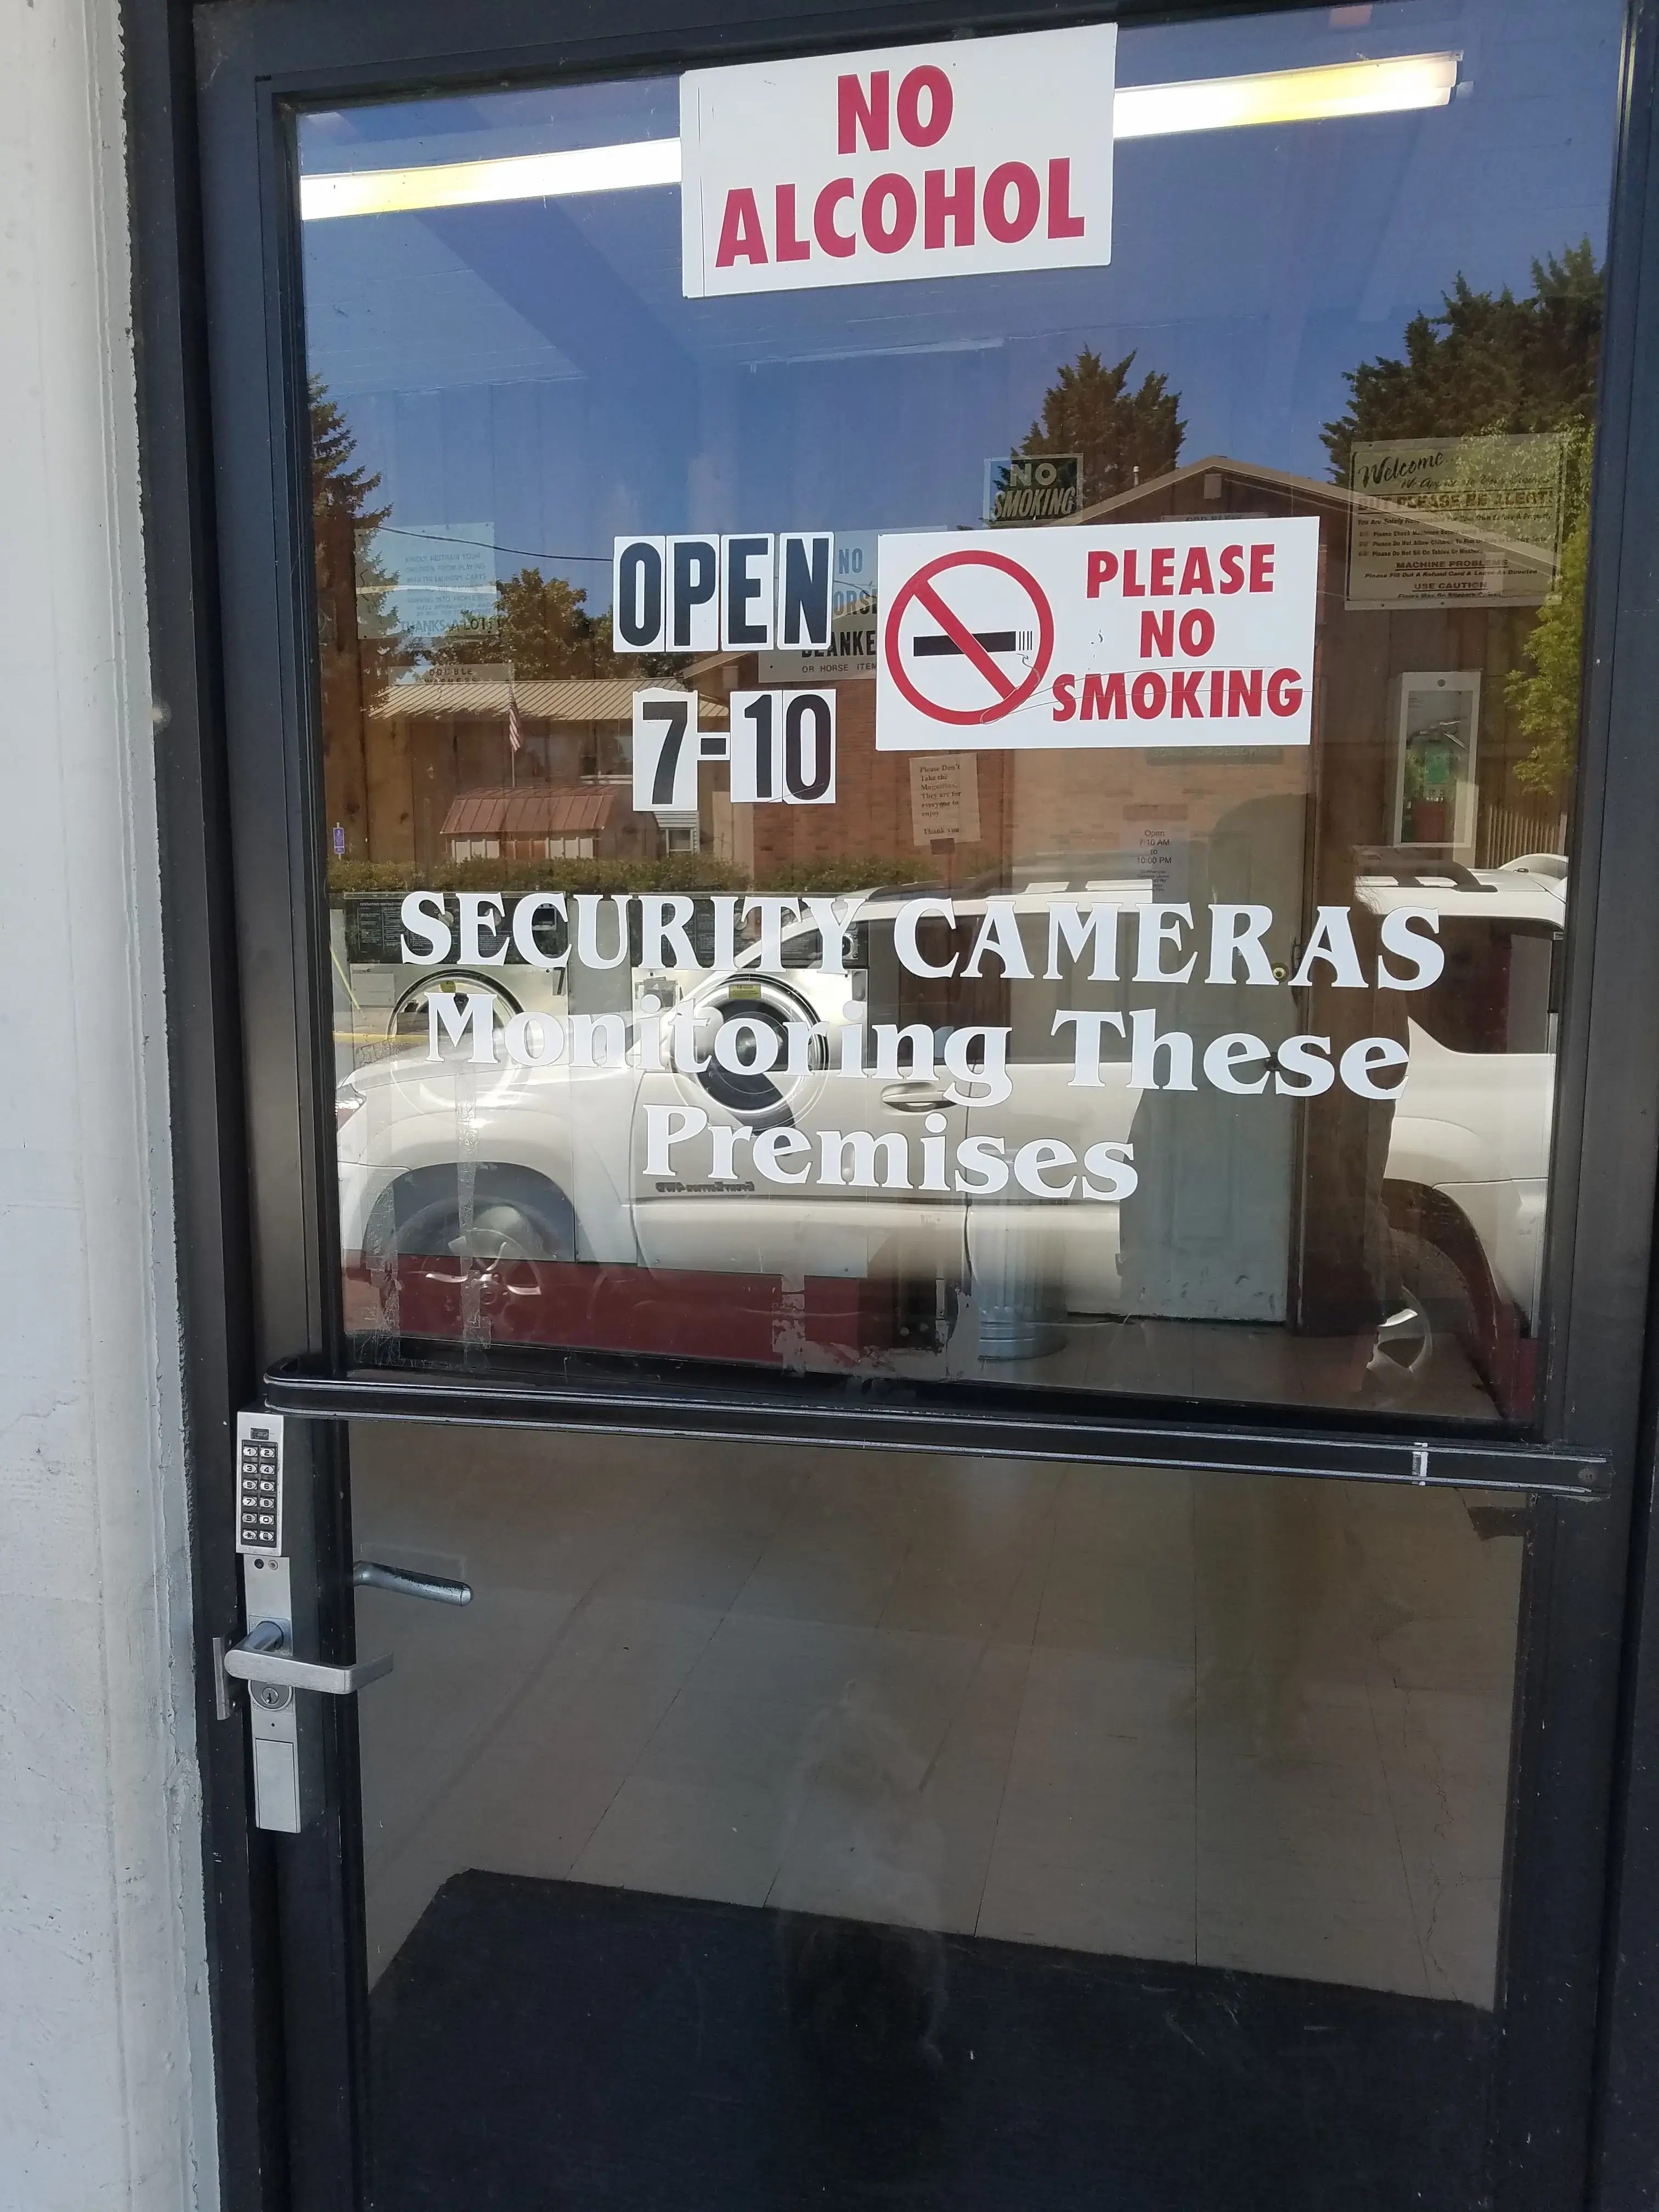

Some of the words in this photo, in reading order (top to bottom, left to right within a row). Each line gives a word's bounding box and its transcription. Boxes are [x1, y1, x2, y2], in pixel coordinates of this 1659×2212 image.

[837, 64, 953, 155] NO
[715, 157, 1085, 268] ALCOHOL
[1010, 463, 1057, 487] NO
[1397, 493, 1460, 509] PLEASE
[991, 486, 1076, 520] SMOKING
[839, 548, 863, 574] NO
[1086, 544, 1276, 599] PLEASE
[619, 538, 830, 646] OPEN
[833, 588, 877, 617] ORSE
[1140, 607, 1215, 658] NO
[429, 667, 473, 676] DOUBLE
[820, 664, 849, 672] HORSE
[1052, 668, 1304, 723] SMOKING
[642, 693, 831, 805] 7-10
[1144, 830, 1165, 838] Open
[401, 891, 867, 975] SECURITY
[893, 898, 1445, 991] CAMERAS
[424, 991, 1013, 1107] Monitoring
[1051, 1008, 1410, 1100] These
[642, 1104, 1138, 1200] Premises
